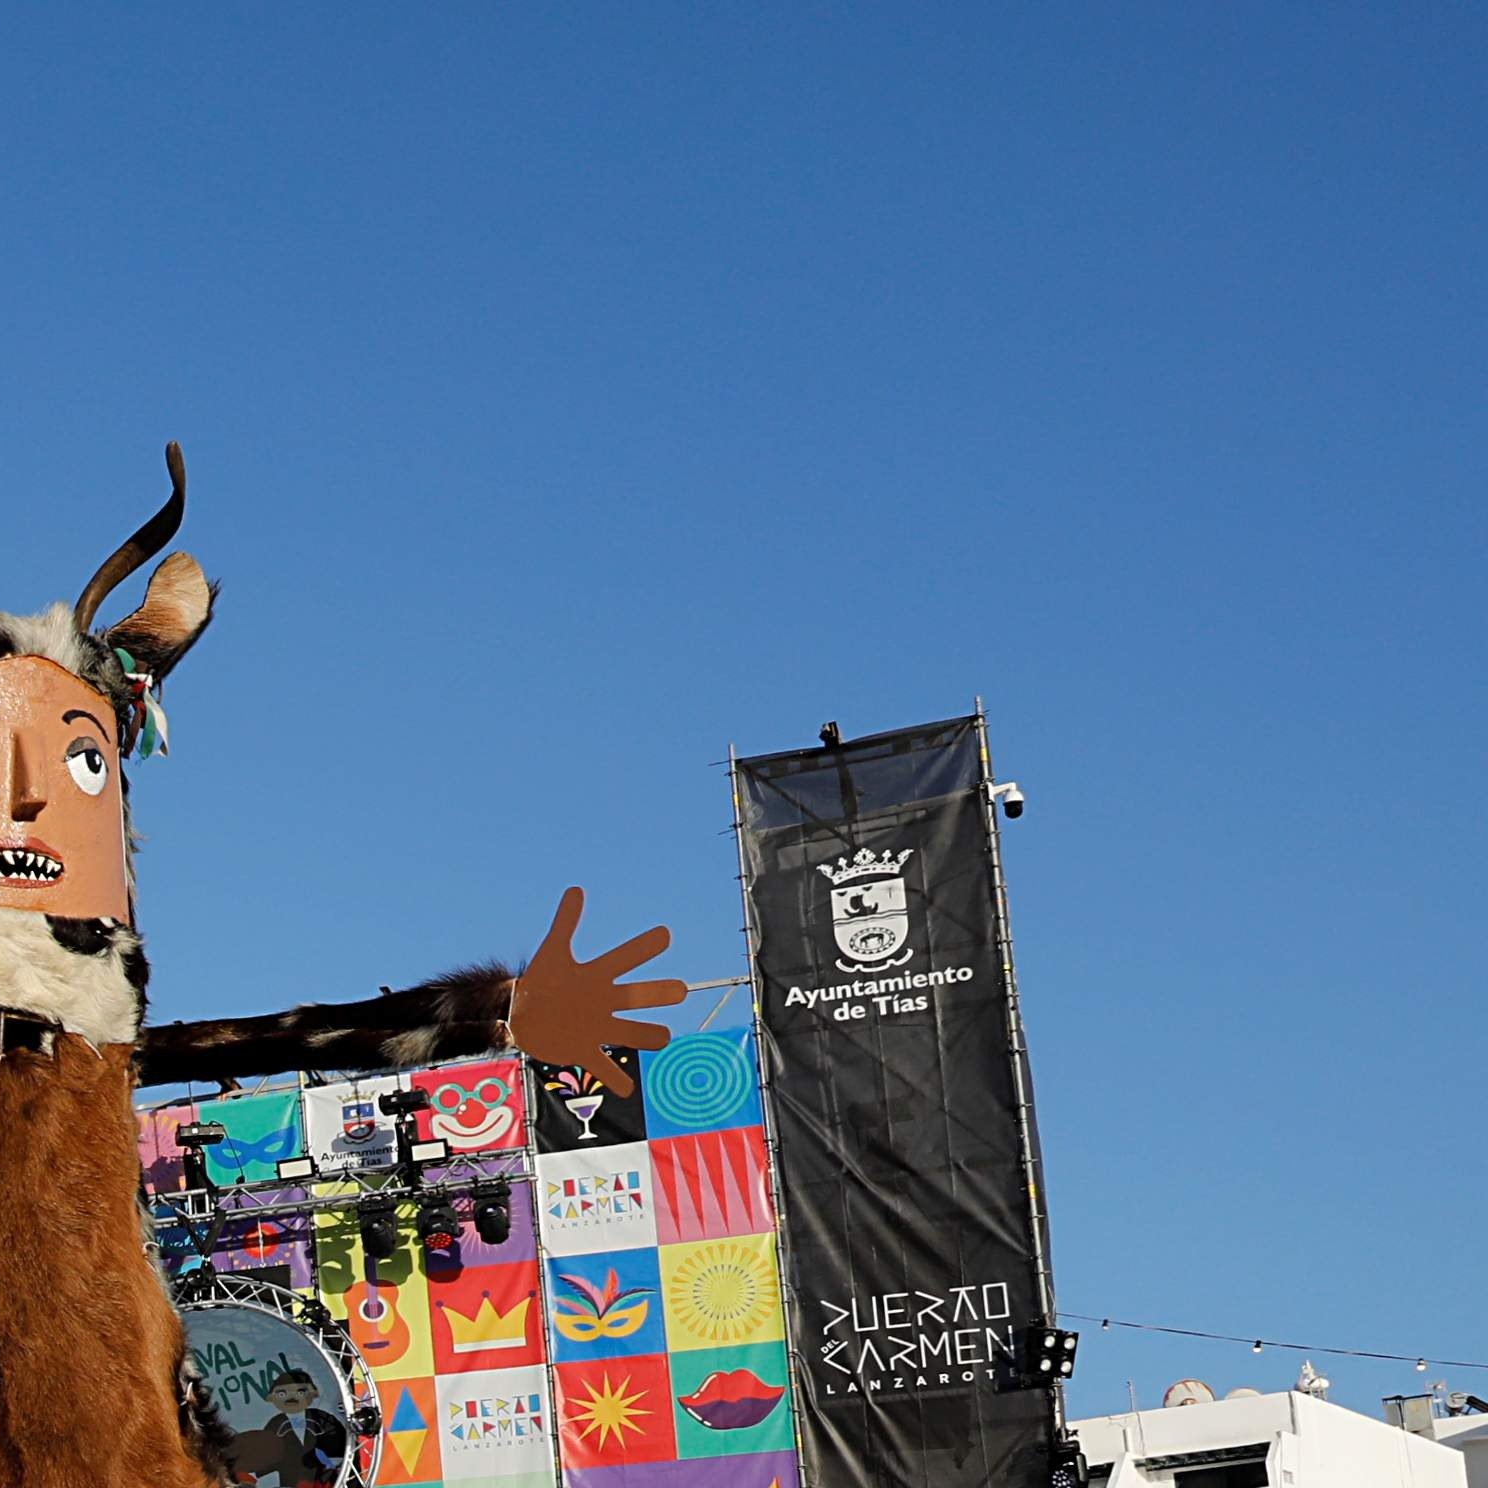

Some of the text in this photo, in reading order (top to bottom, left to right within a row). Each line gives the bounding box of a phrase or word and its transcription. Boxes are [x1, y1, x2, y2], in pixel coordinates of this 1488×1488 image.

[784, 966, 973, 1009] Ayuntamiento
[834, 994, 928, 1021] de Tías
[551, 1214, 643, 1230] LANZAROTE
[821, 1282, 1011, 1336] PUERTO
[821, 1339, 840, 1354] DEL
[823, 1325, 1015, 1374] CARMEN
[826, 1368, 1017, 1395] LANZAROTE
[452, 1438, 544, 1452] LANZAROTE
